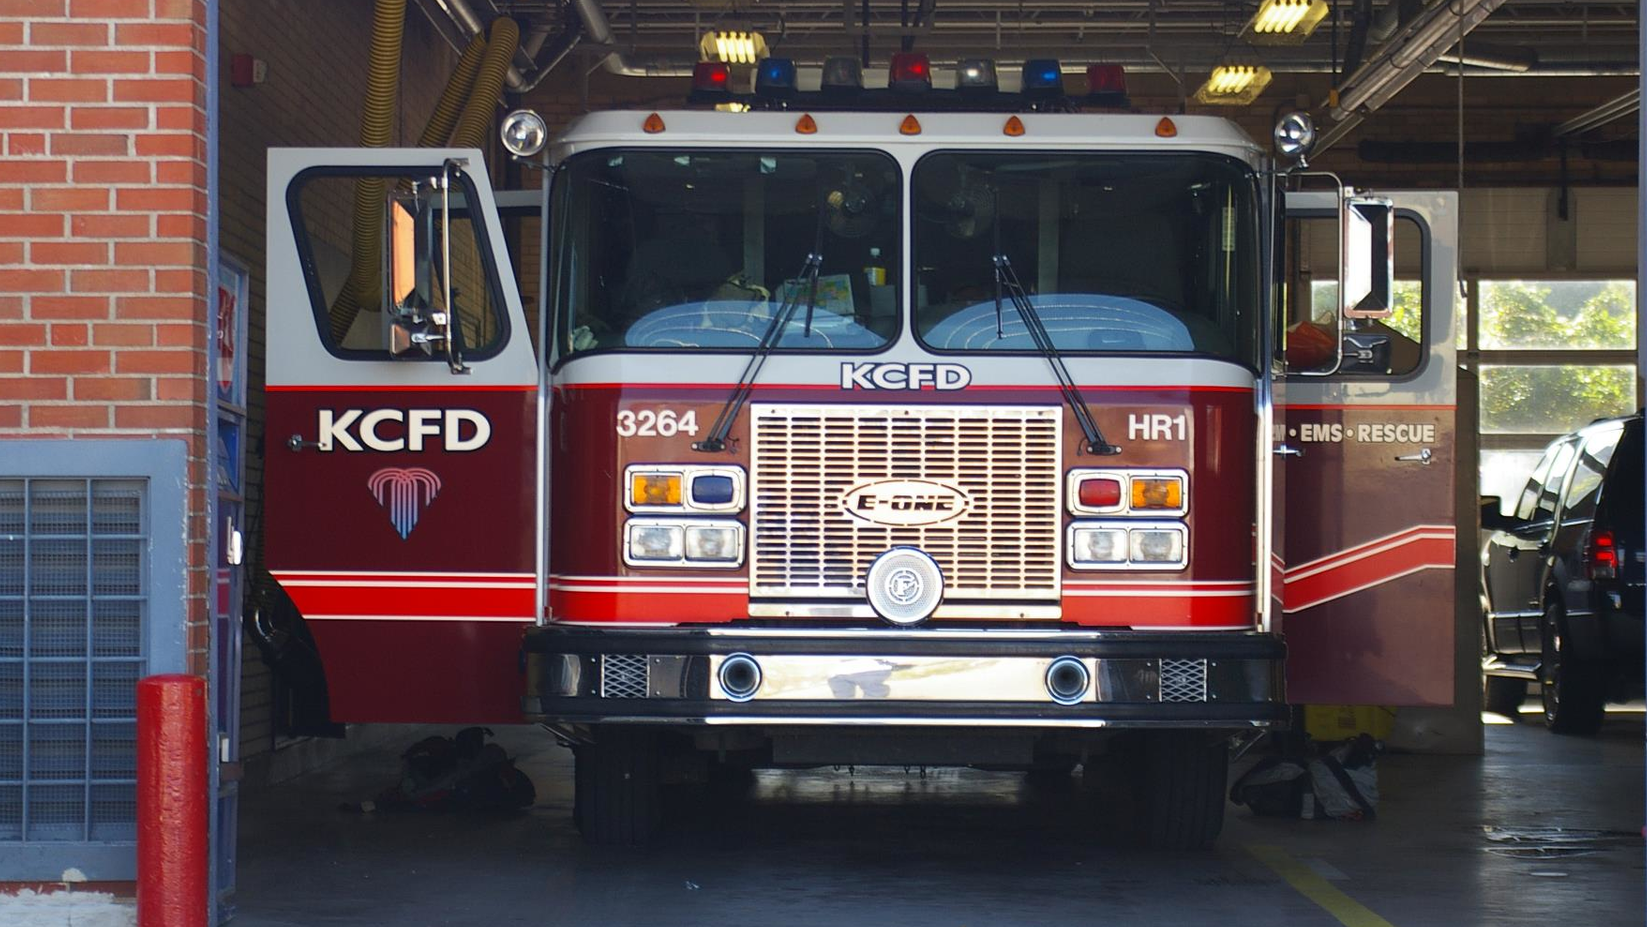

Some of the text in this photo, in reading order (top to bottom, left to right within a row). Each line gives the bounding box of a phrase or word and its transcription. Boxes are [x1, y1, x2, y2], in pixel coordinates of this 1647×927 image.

[841, 362, 971, 390] KCFD
[318, 408, 491, 452] KCFD
[616, 409, 698, 436] 3264
[1128, 413, 1185, 440] HR1
[1300, 423, 1342, 442] EMS
[1357, 424, 1435, 443] RESCUE
[857, 495, 954, 510] E-ONE
